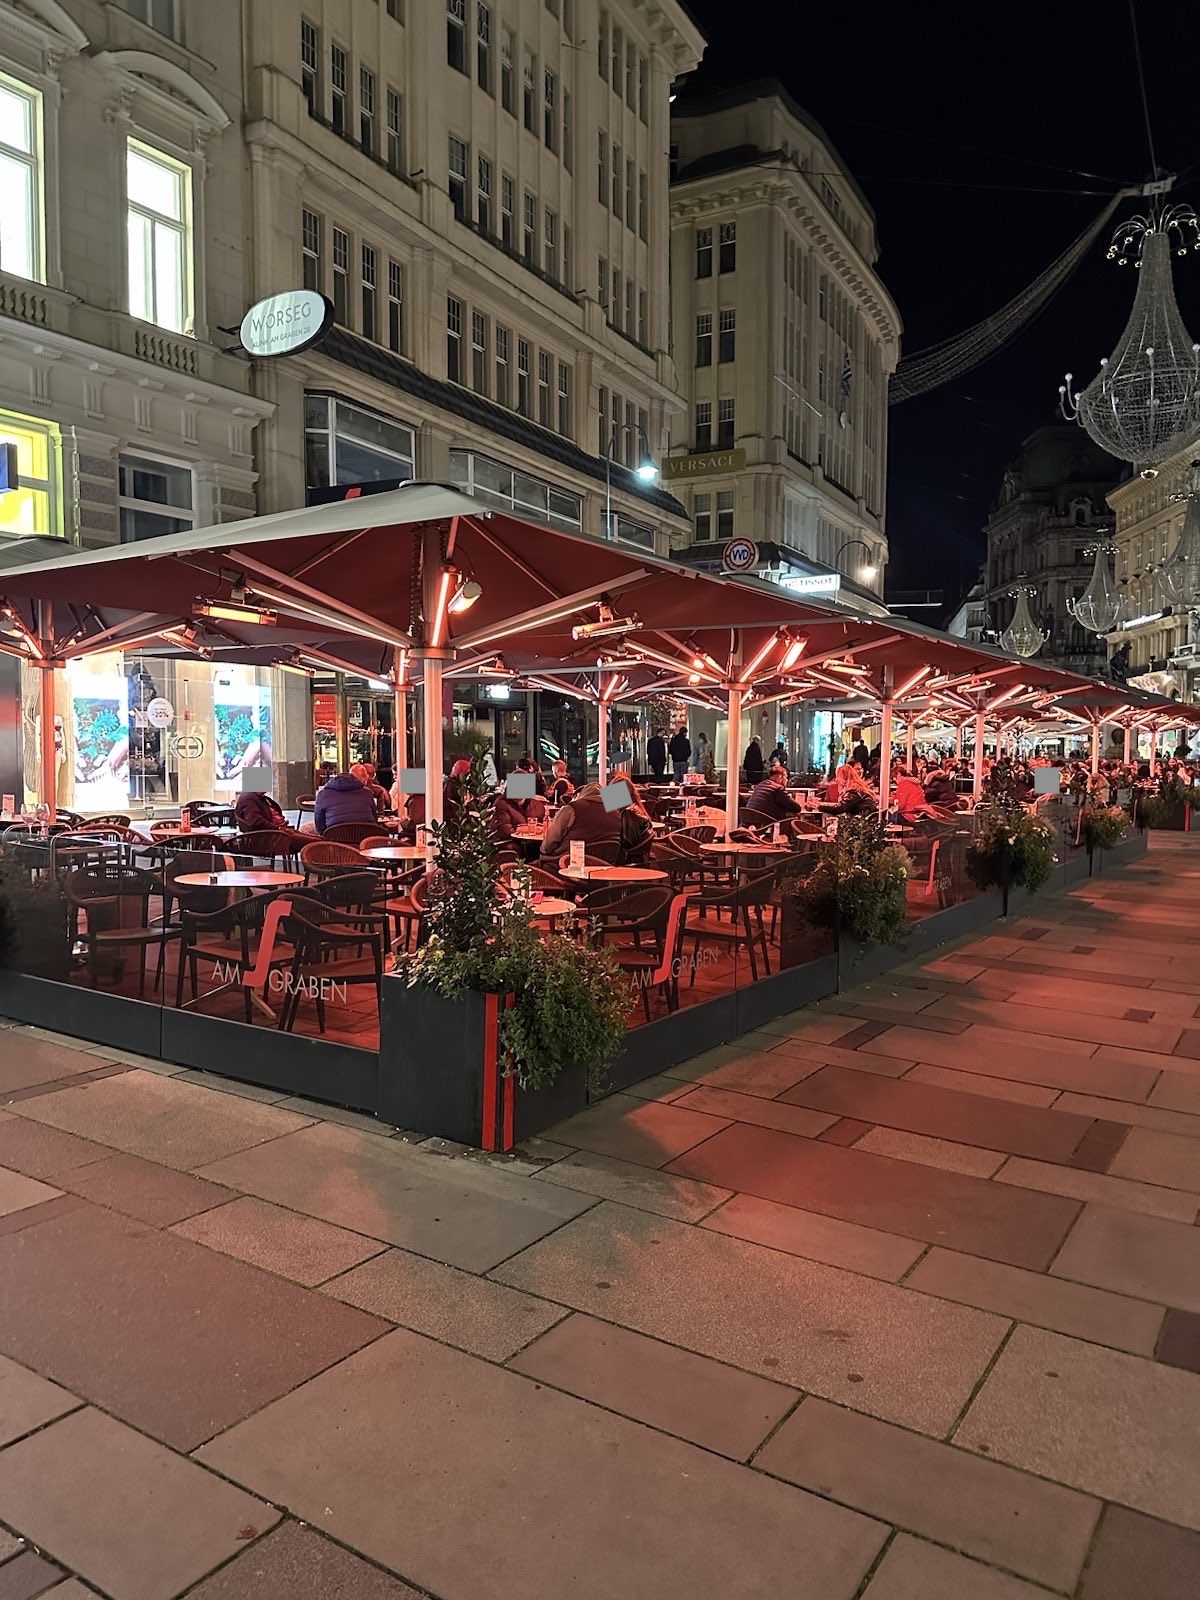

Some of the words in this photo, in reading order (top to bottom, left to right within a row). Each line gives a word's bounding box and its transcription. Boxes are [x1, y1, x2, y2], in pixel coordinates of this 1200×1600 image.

[252, 302, 311, 332] WORSEG
[670, 455, 737, 473] VERSACE
[800, 577, 832, 587] TISSOT
[211, 960, 241, 985] AM
[268, 969, 347, 1005] GRABEN
[630, 966, 653, 992] AM
[672, 946, 719, 978] GRABEN
